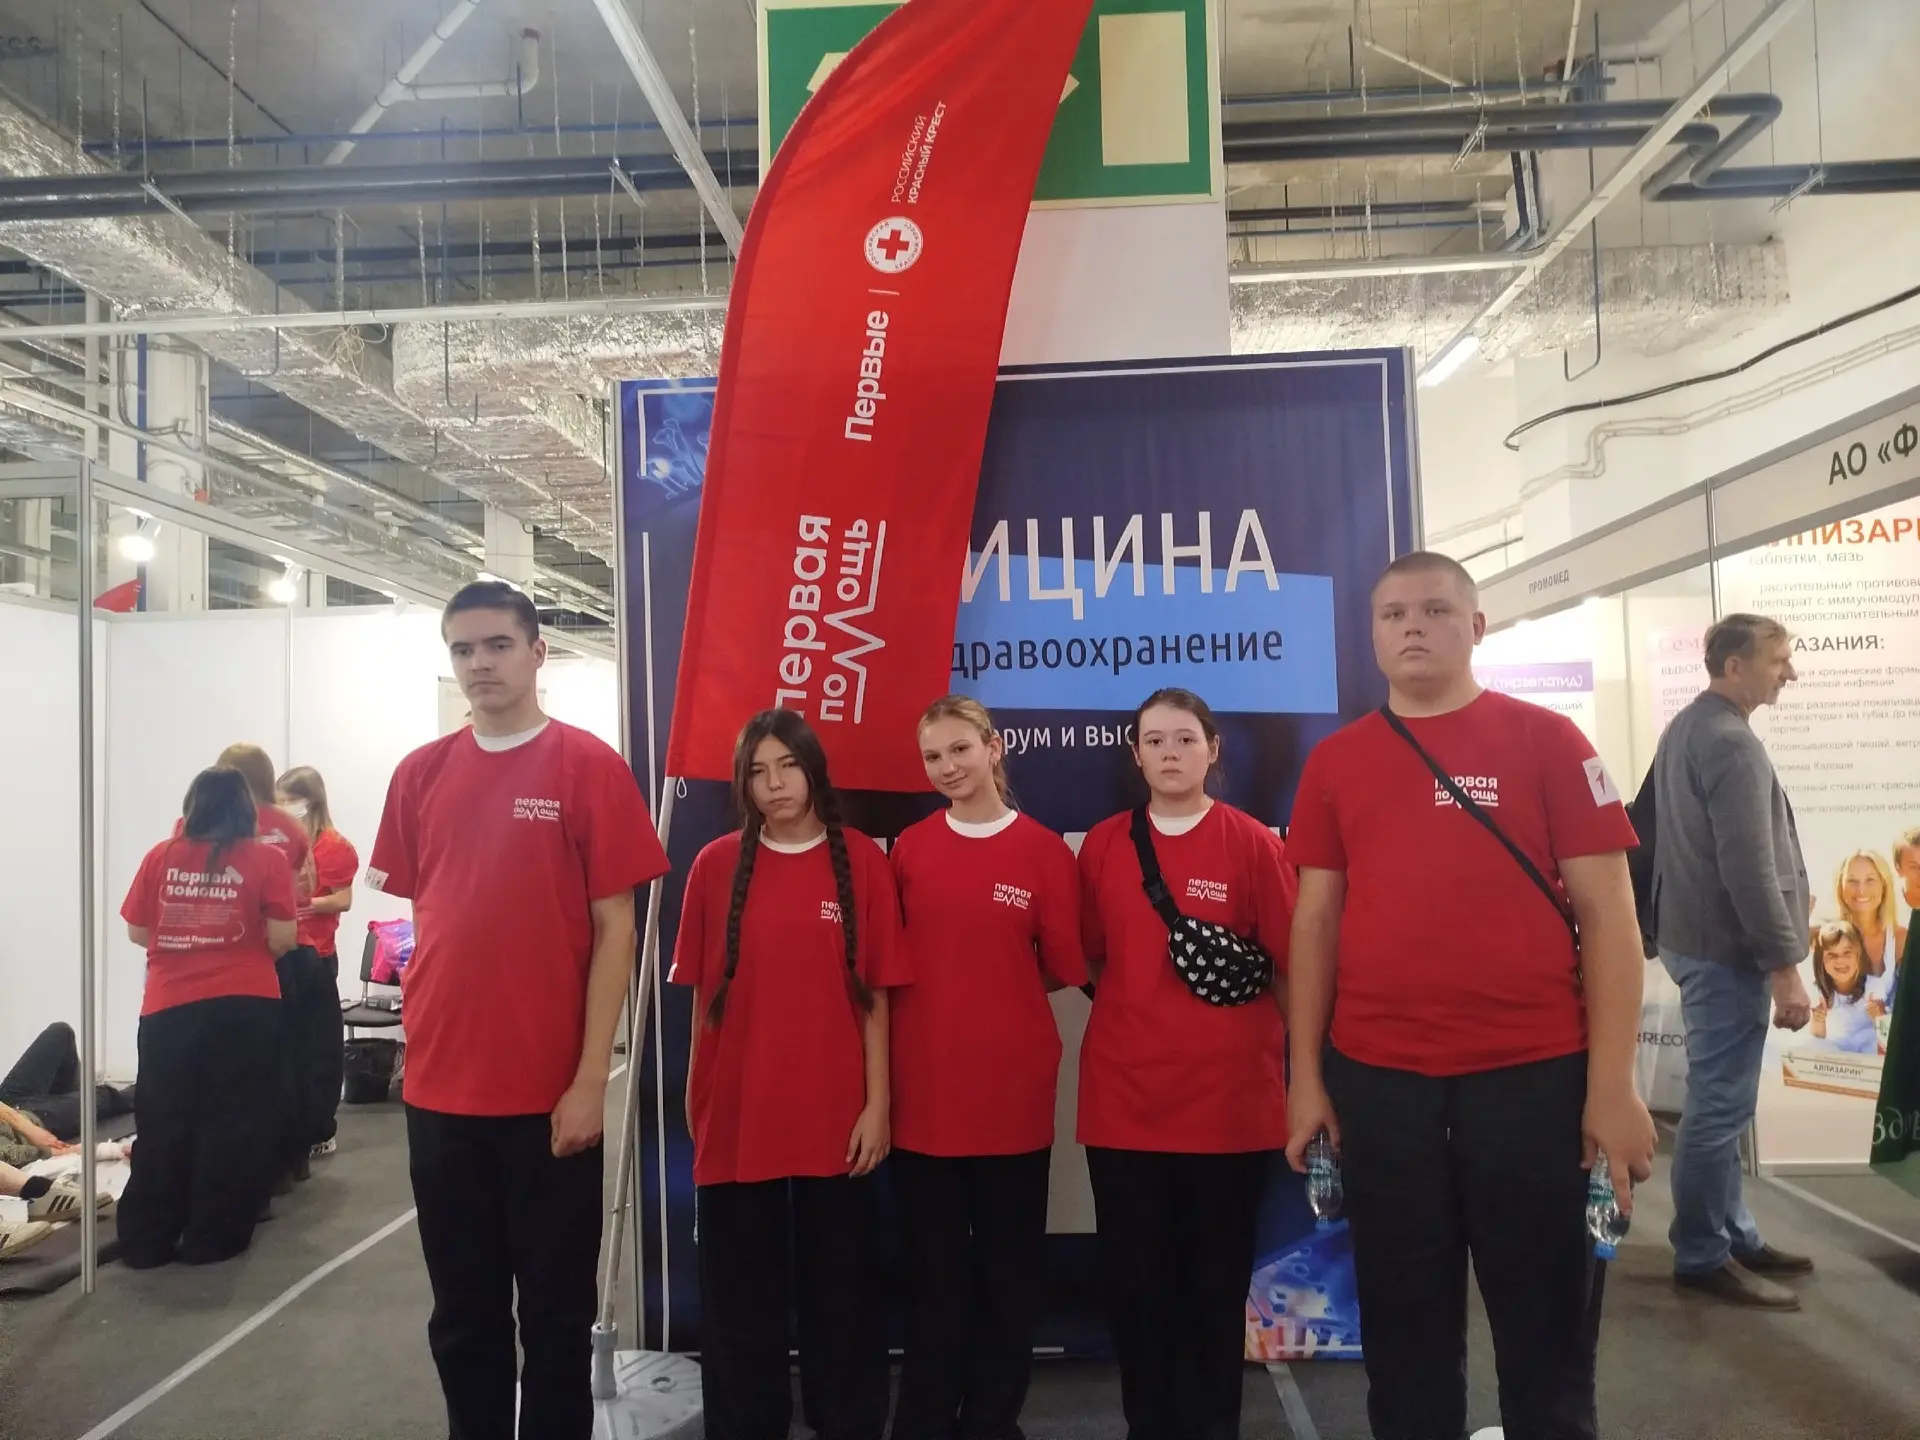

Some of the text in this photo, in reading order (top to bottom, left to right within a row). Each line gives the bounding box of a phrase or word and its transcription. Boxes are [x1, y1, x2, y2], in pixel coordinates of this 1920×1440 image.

[891, 114, 927, 203] РОССИЙСКИЙ
[907, 100, 947, 204] КРАСНЫЙ КРЕСТ
[844, 310, 889, 442] Первые
[1828, 441, 1868, 486] АО
[1826, 551, 1864, 563] мазь
[1528, 568, 1570, 596] ПРОМОМЕД
[1760, 579, 1853, 595] растительный
[1752, 597, 1813, 610] препарат
[1817, 598, 1825, 607] с
[952, 628, 1284, 680] дравоохранение
[1791, 634, 1886, 652] АЗАНИЯ:
[1061, 726, 1075, 748] и
[994, 882, 1032, 901] первая
[1188, 878, 1228, 892] первая
